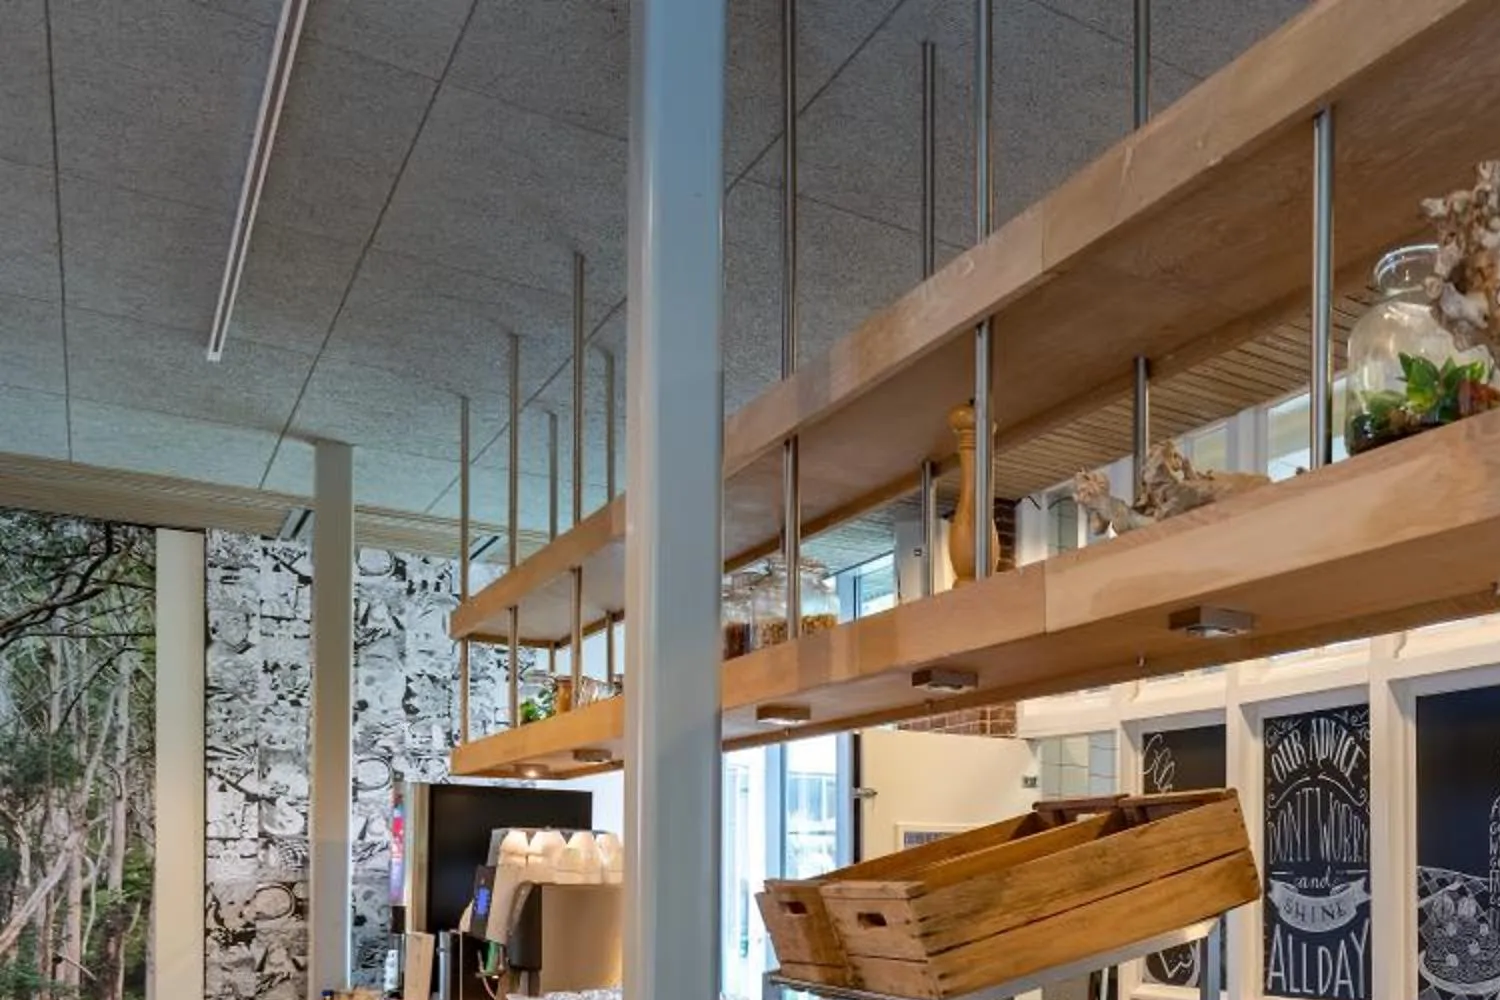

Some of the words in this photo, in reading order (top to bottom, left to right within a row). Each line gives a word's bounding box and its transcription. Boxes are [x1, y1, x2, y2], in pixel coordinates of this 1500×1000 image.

[1271, 729, 1308, 784] OUR
[1309, 718, 1367, 788] ADVICE
[1315, 787, 1368, 863] WORRY
[1267, 923, 1314, 993] ALL
[1317, 917, 1370, 1000] DAY
